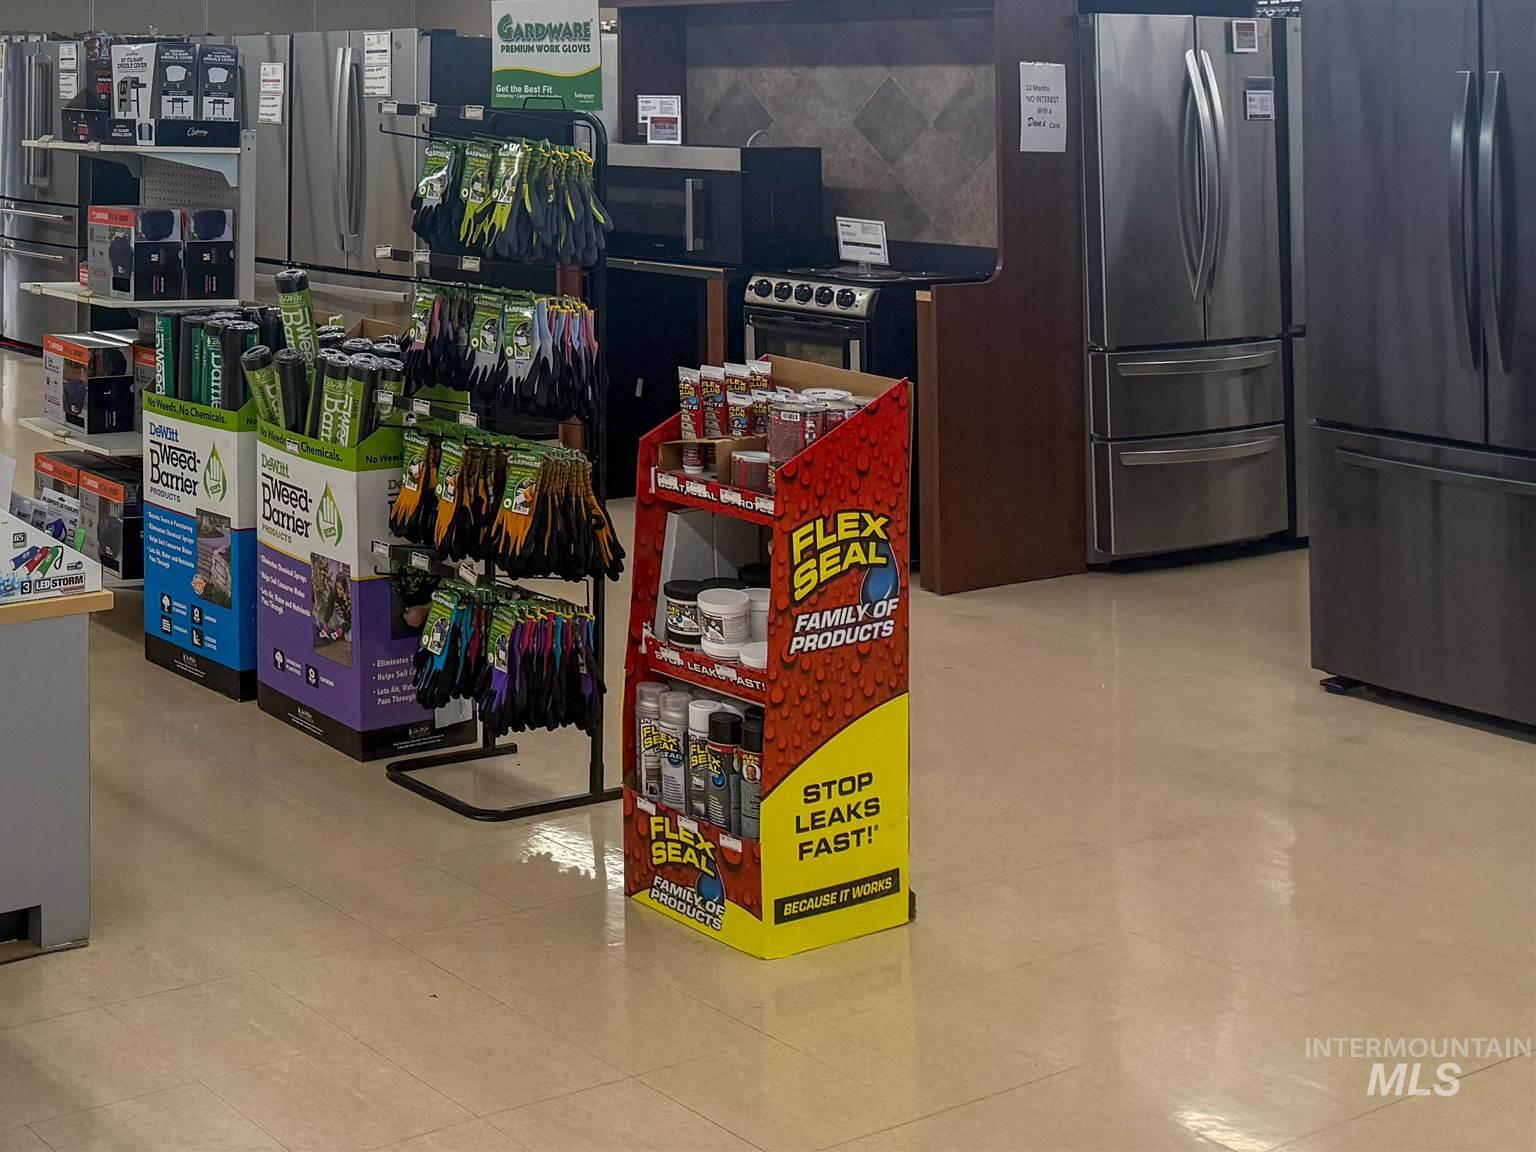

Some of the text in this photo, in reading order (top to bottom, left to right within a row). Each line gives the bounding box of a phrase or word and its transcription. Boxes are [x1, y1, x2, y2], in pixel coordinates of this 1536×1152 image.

[497, 14, 592, 42] GARDWARE
[500, 44, 591, 54] PREMIUM WORK GLOVES
[496, 84, 552, 94] Get the Best Fit
[1026, 95, 1035, 103] NO
[702, 381, 720, 389] FLEX
[147, 397, 227, 425] No Weeds. No Chemicals.
[246, 417, 257, 425] No
[149, 422, 180, 443] DeWitt
[260, 426, 267, 437] No
[301, 441, 343, 462] Chemicals.
[151, 440, 201, 473] Weed-
[261, 454, 290, 479] DeWitt
[365, 452, 403, 464] No Weed
[150, 448, 199, 496] Barrier
[150, 487, 181, 503] PRODUCTS
[262, 473, 313, 513] Weed-
[262, 482, 313, 538] Barrier
[182, 534, 194, 545] Sprays
[262, 523, 293, 544] PRODUCTS
[792, 512, 889, 566] FLEX
[182, 546, 193, 556] Water
[22, 582, 31, 593] 3
[51, 575, 84, 588] STORM
[294, 570, 307, 584] Sprays
[793, 541, 888, 602] SEAL
[794, 598, 900, 633] FAMILY OF
[789, 619, 895, 655] PRODUCTS
[377, 658, 409, 668] Eliminates
[377, 669, 408, 681] Helps Soil
[377, 685, 402, 695] Lets Air,
[377, 697, 391, 705] Pass
[742, 754, 760, 762] FLEX
[803, 771, 874, 805] STOP
[795, 797, 881, 834] LEAKS
[650, 816, 715, 861] FLEX
[798, 825, 873, 862] FAST!
[651, 841, 715, 878] SEAL
[650, 887, 722, 931] PRODUCTS
[653, 875, 726, 918] FAMILY OF
[783, 876, 893, 917] BECAUSE IT WORKS
